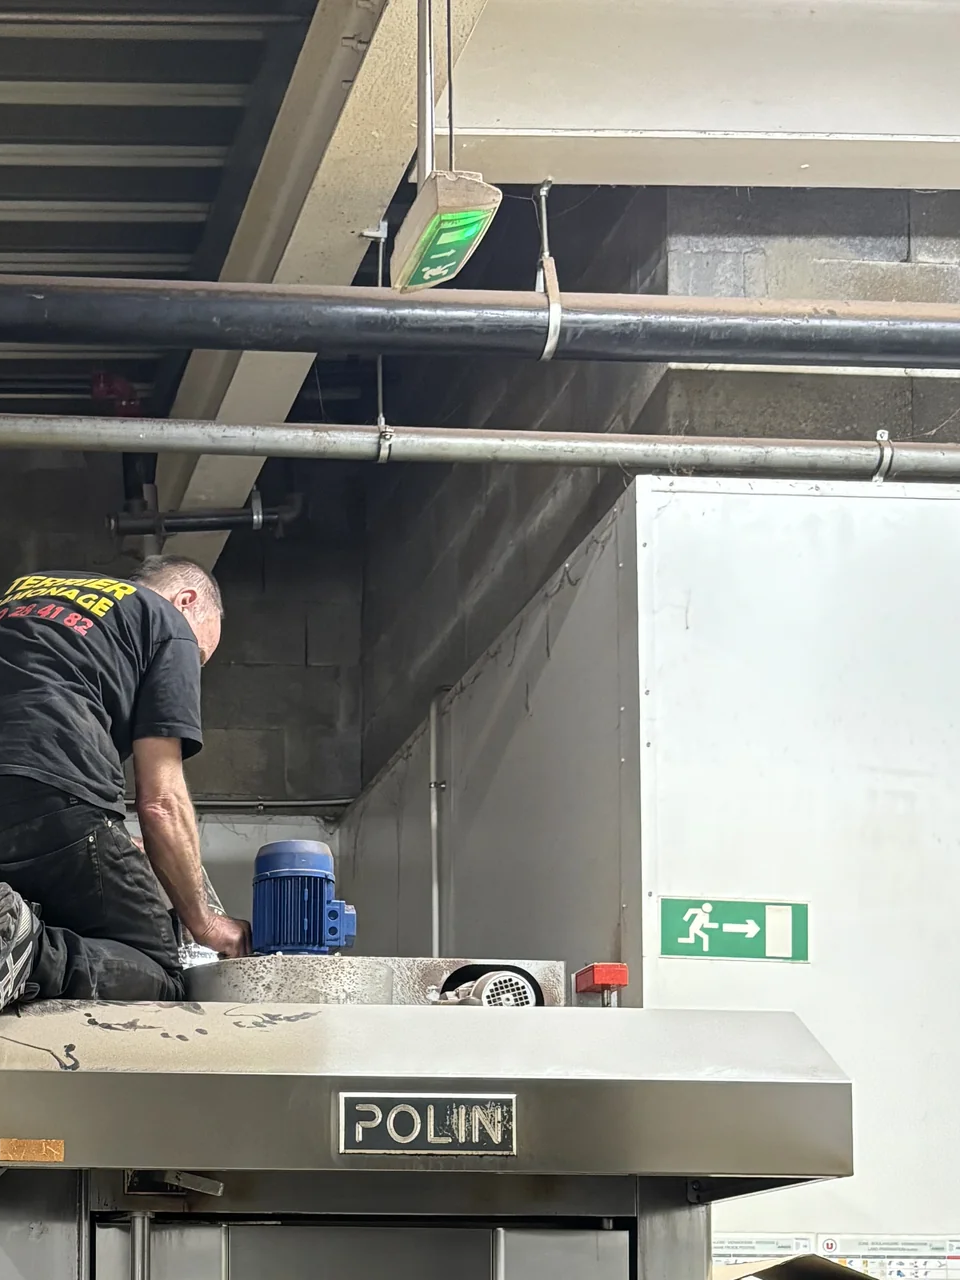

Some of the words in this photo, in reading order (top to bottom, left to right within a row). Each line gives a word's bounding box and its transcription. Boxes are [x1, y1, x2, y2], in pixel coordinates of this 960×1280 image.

[38, 604, 64, 619] 41
[64, 612, 94, 636] 82
[355, 1103, 502, 1144] POLIN
